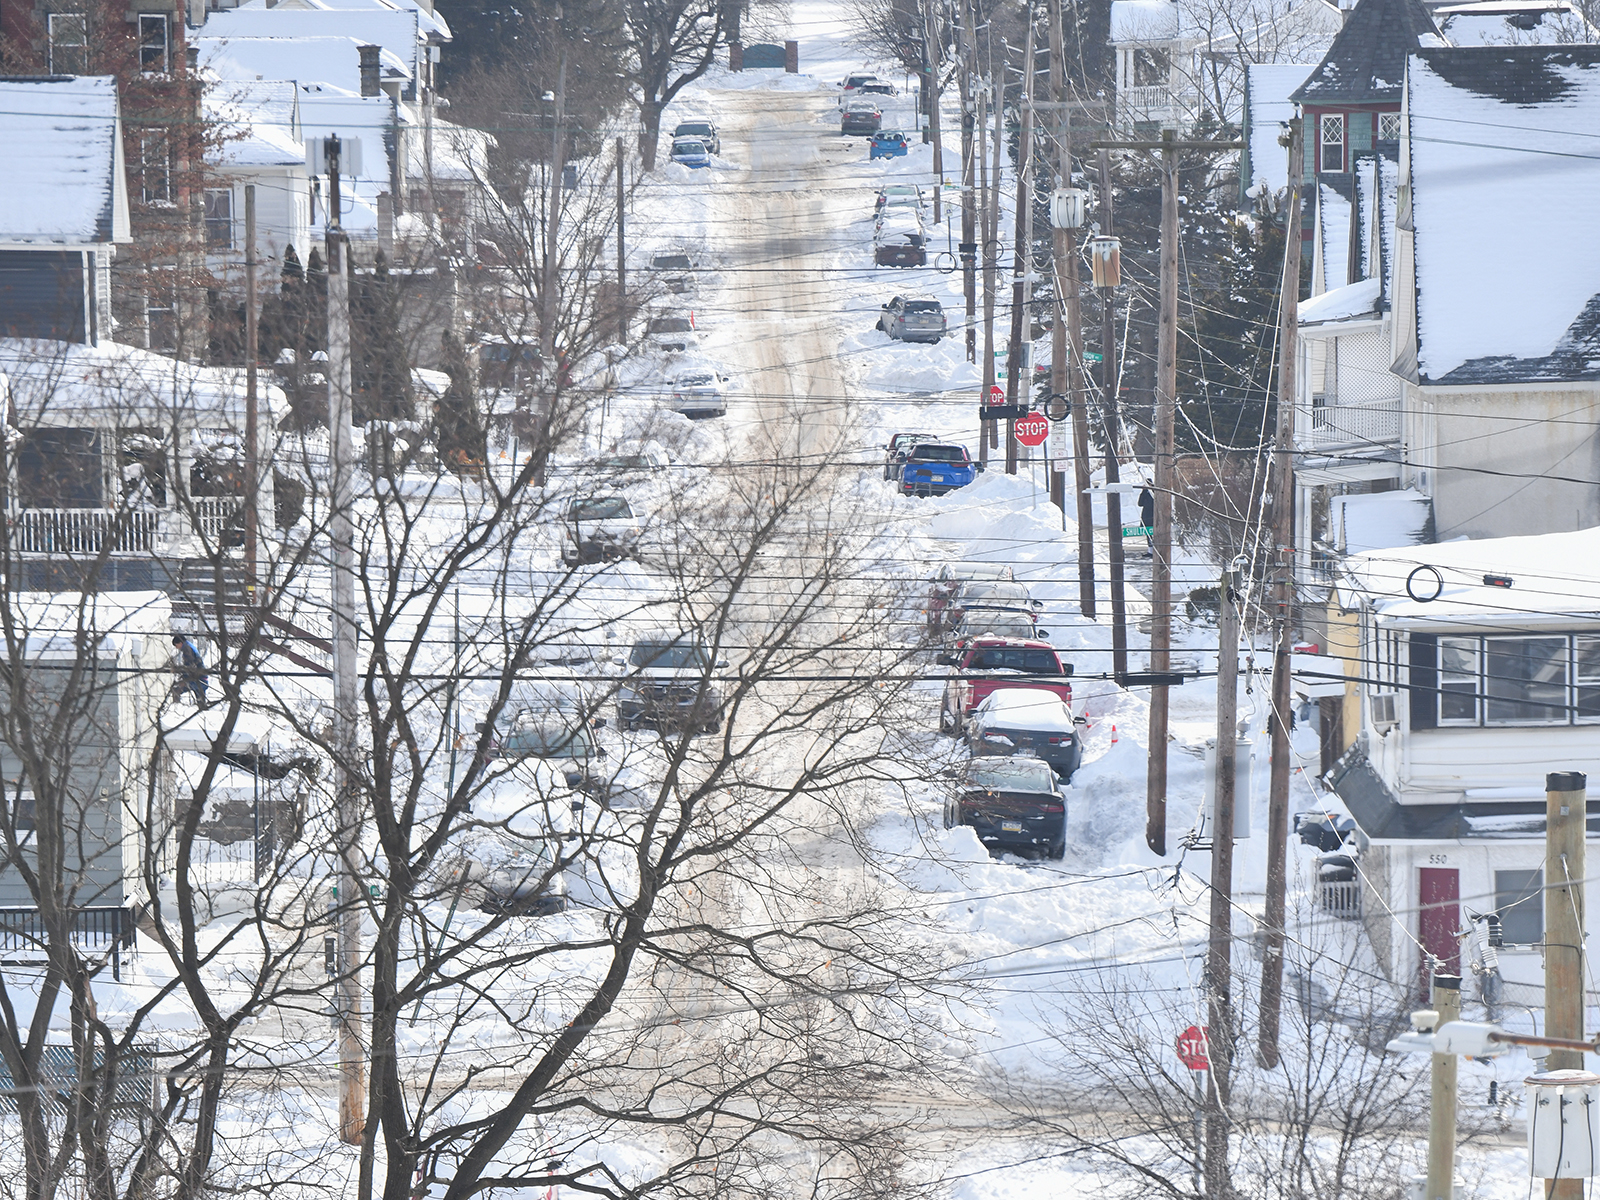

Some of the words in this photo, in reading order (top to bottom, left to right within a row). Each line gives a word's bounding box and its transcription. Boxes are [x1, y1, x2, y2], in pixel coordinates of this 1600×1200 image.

[1016, 422, 1047, 436] STOP
[1429, 854, 1448, 865] 550
[1181, 1039, 1208, 1056] STO
